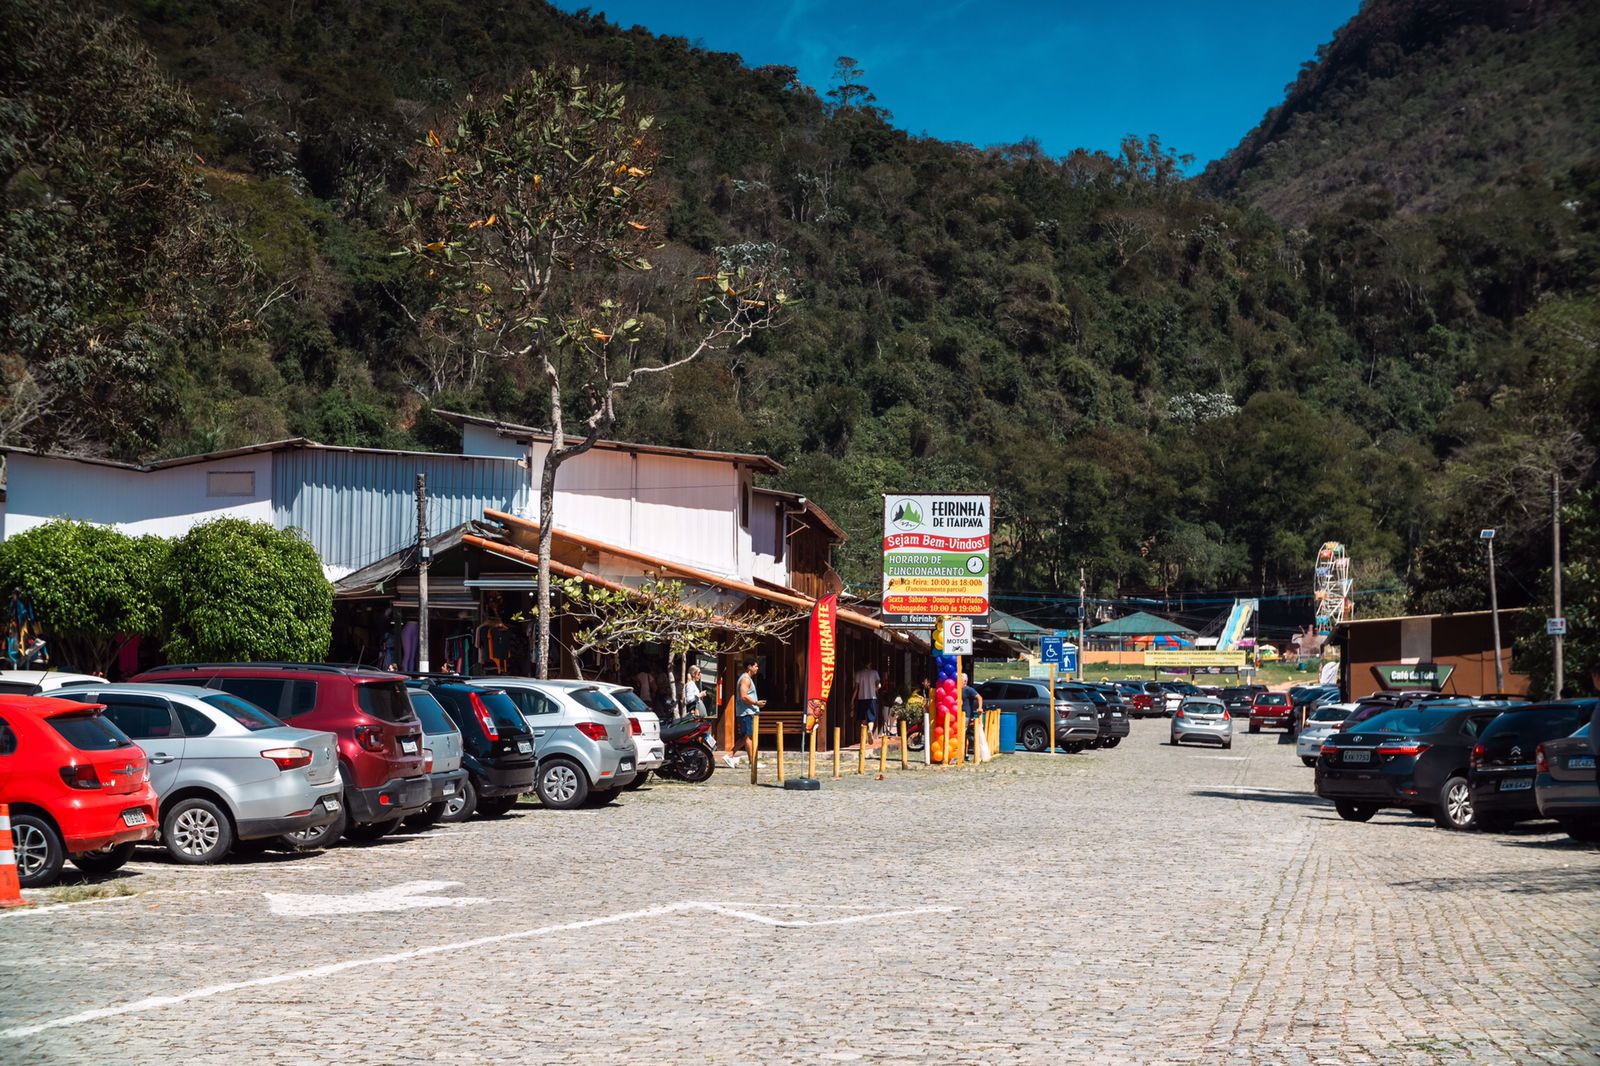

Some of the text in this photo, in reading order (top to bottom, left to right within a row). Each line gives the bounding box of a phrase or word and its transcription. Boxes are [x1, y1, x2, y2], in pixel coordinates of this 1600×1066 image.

[932, 502, 985, 516] FEIRINHA
[933, 518, 983, 527] DE ITAIPAVA
[888, 535, 986, 550] Sejam Bem-Vindos!
[931, 556, 942, 564] DE
[888, 567, 964, 576] FUNCIONAMENTO
[955, 626, 960, 634] E
[818, 603, 835, 698] RESTAURANTE
[1391, 670, 1408, 680] Café
[1409, 671, 1419, 680] da
